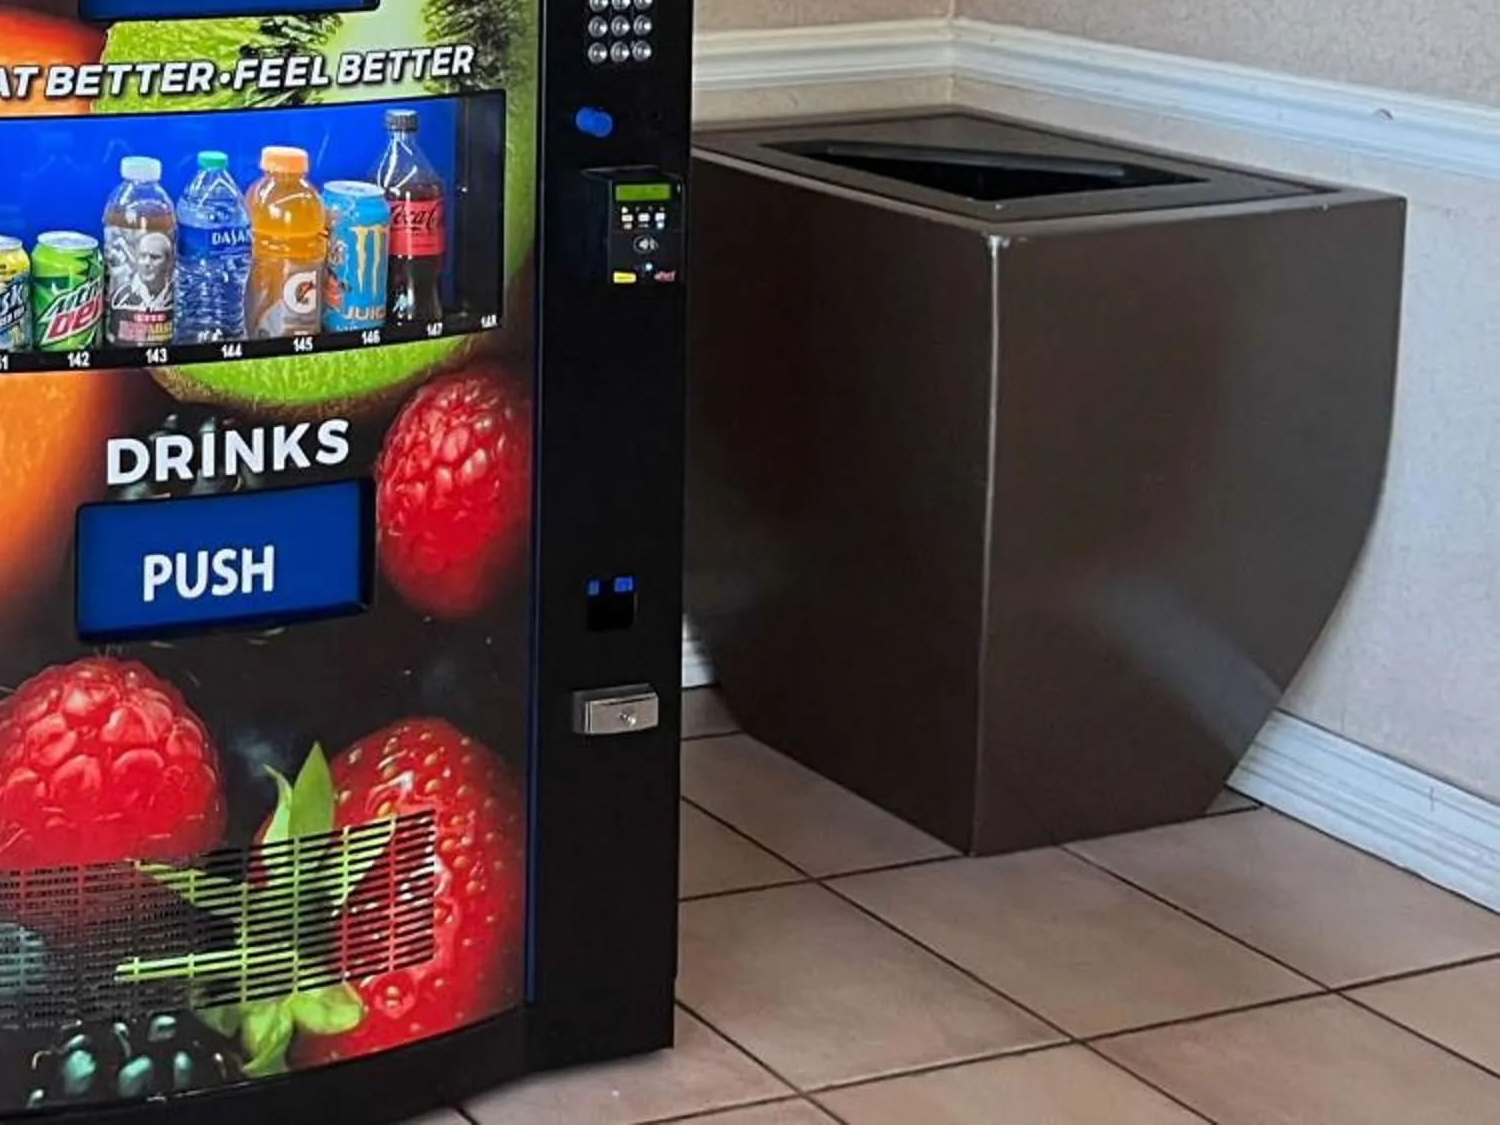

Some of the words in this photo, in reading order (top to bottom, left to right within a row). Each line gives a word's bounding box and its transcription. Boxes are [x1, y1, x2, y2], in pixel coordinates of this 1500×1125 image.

[45, 62, 216, 97] BETTER
[231, 57, 329, 91] FEEL
[338, 45, 474, 85] BETTER
[283, 270, 317, 314] G
[427, 322, 443, 336] 147
[481, 315, 498, 328] 148
[293, 337, 314, 353] 145
[362, 330, 381, 346] 146
[145, 349, 168, 364] 143
[221, 344, 243, 359] 144
[67, 352, 91, 368] 142
[106, 418, 350, 486] DRINKS
[142, 544, 276, 603] PUSH
